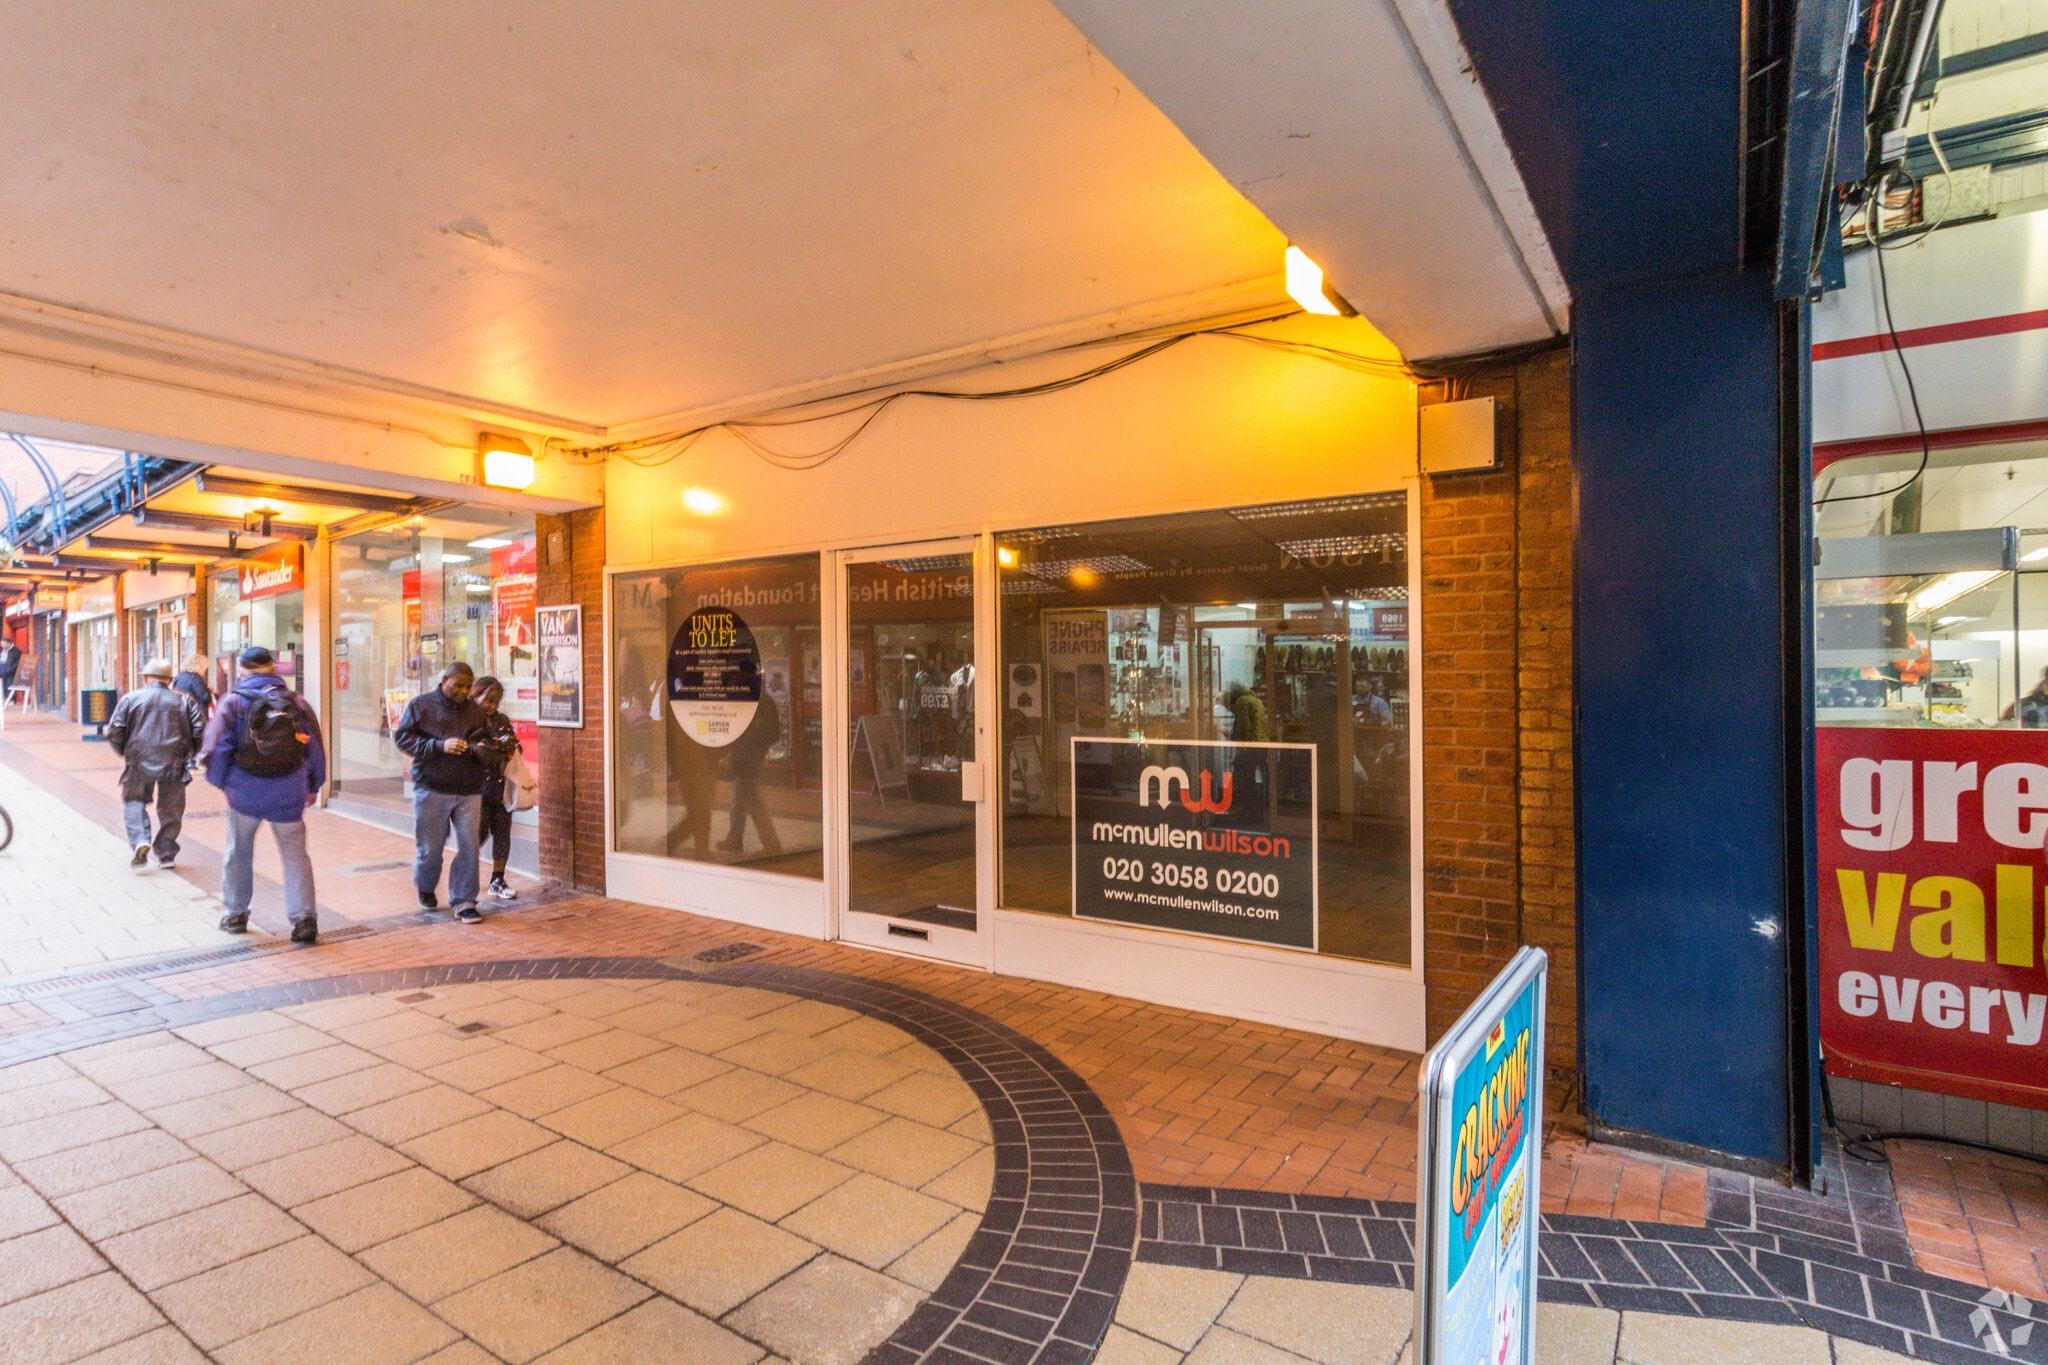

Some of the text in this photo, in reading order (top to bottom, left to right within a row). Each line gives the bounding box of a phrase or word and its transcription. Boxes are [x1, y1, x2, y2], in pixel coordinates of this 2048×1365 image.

[253, 558, 294, 591] Santander
[541, 616, 565, 636] VAN
[692, 613, 733, 632] UNITS
[541, 635, 579, 647] MORRISON
[689, 630, 737, 648] TO LET
[708, 726, 730, 734] SQUARE
[1103, 857, 1280, 898] 020 3058 0200
[1104, 888, 1280, 921] www.mcmullenwilson.com
[1838, 970, 2048, 1046] every
[1452, 1026, 1530, 1217] CRACKING
